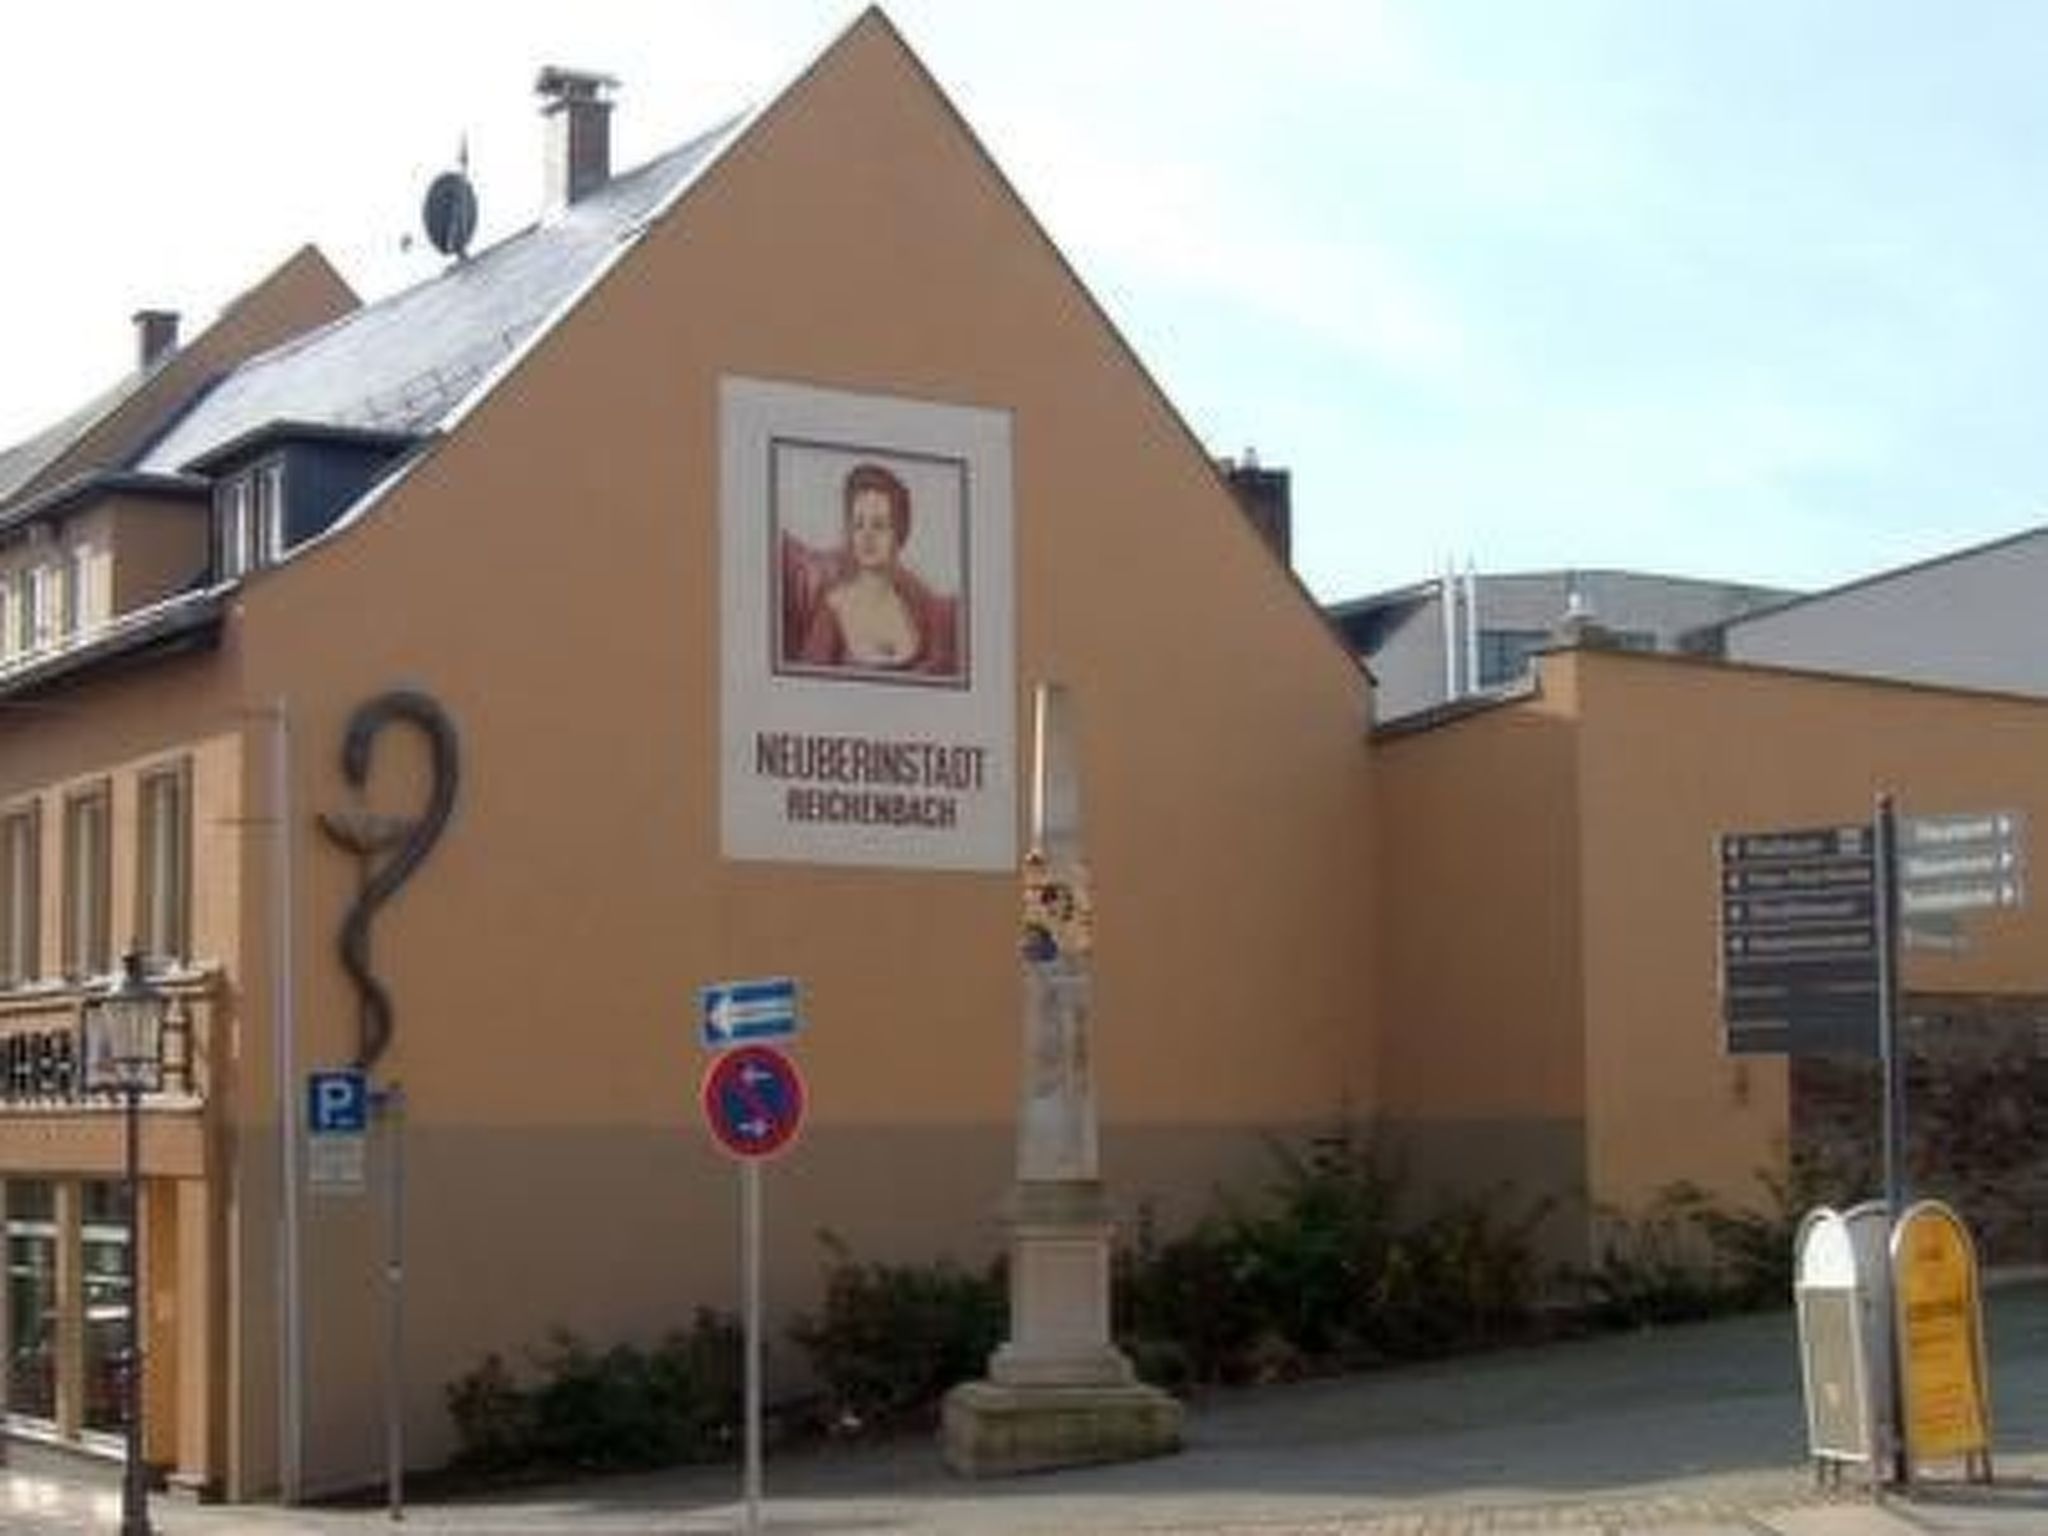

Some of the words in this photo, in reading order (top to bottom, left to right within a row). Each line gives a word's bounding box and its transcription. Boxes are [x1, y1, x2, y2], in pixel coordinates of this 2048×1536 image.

[756, 732, 983, 790] NEUBERINSTADT
[786, 788, 956, 829] REICHENBACH
[318, 1081, 353, 1125] P
